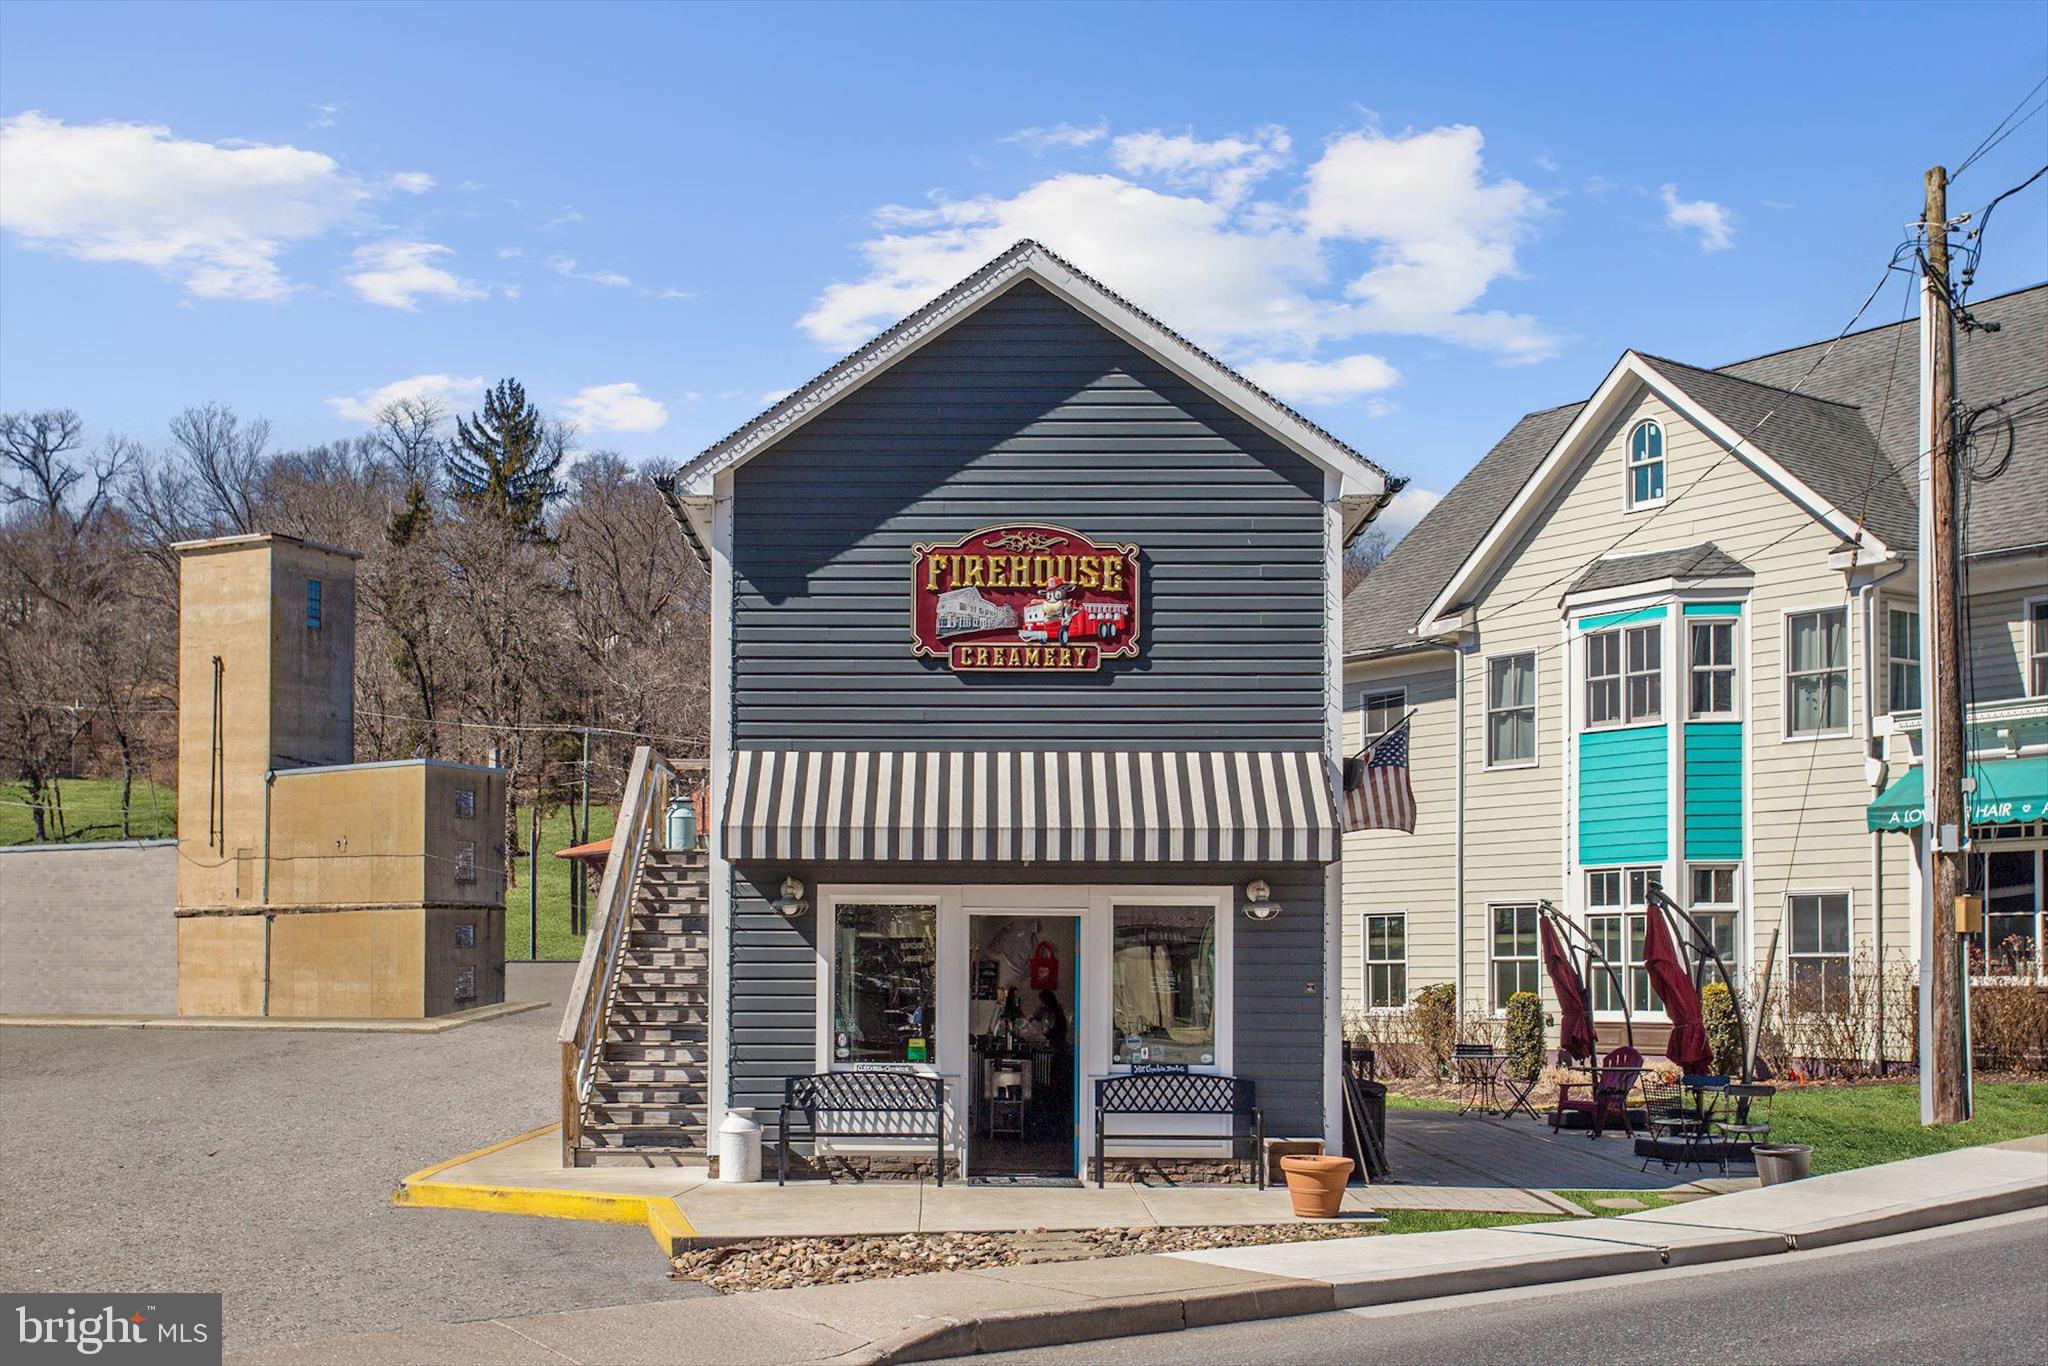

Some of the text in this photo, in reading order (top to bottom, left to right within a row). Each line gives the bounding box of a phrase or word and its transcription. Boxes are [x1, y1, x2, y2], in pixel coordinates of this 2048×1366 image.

[926, 554, 1124, 592] FIREHOUSE
[960, 647, 1089, 667] CREAMERY
[1888, 811, 1900, 824] A
[1975, 802, 2012, 818] HAIR
